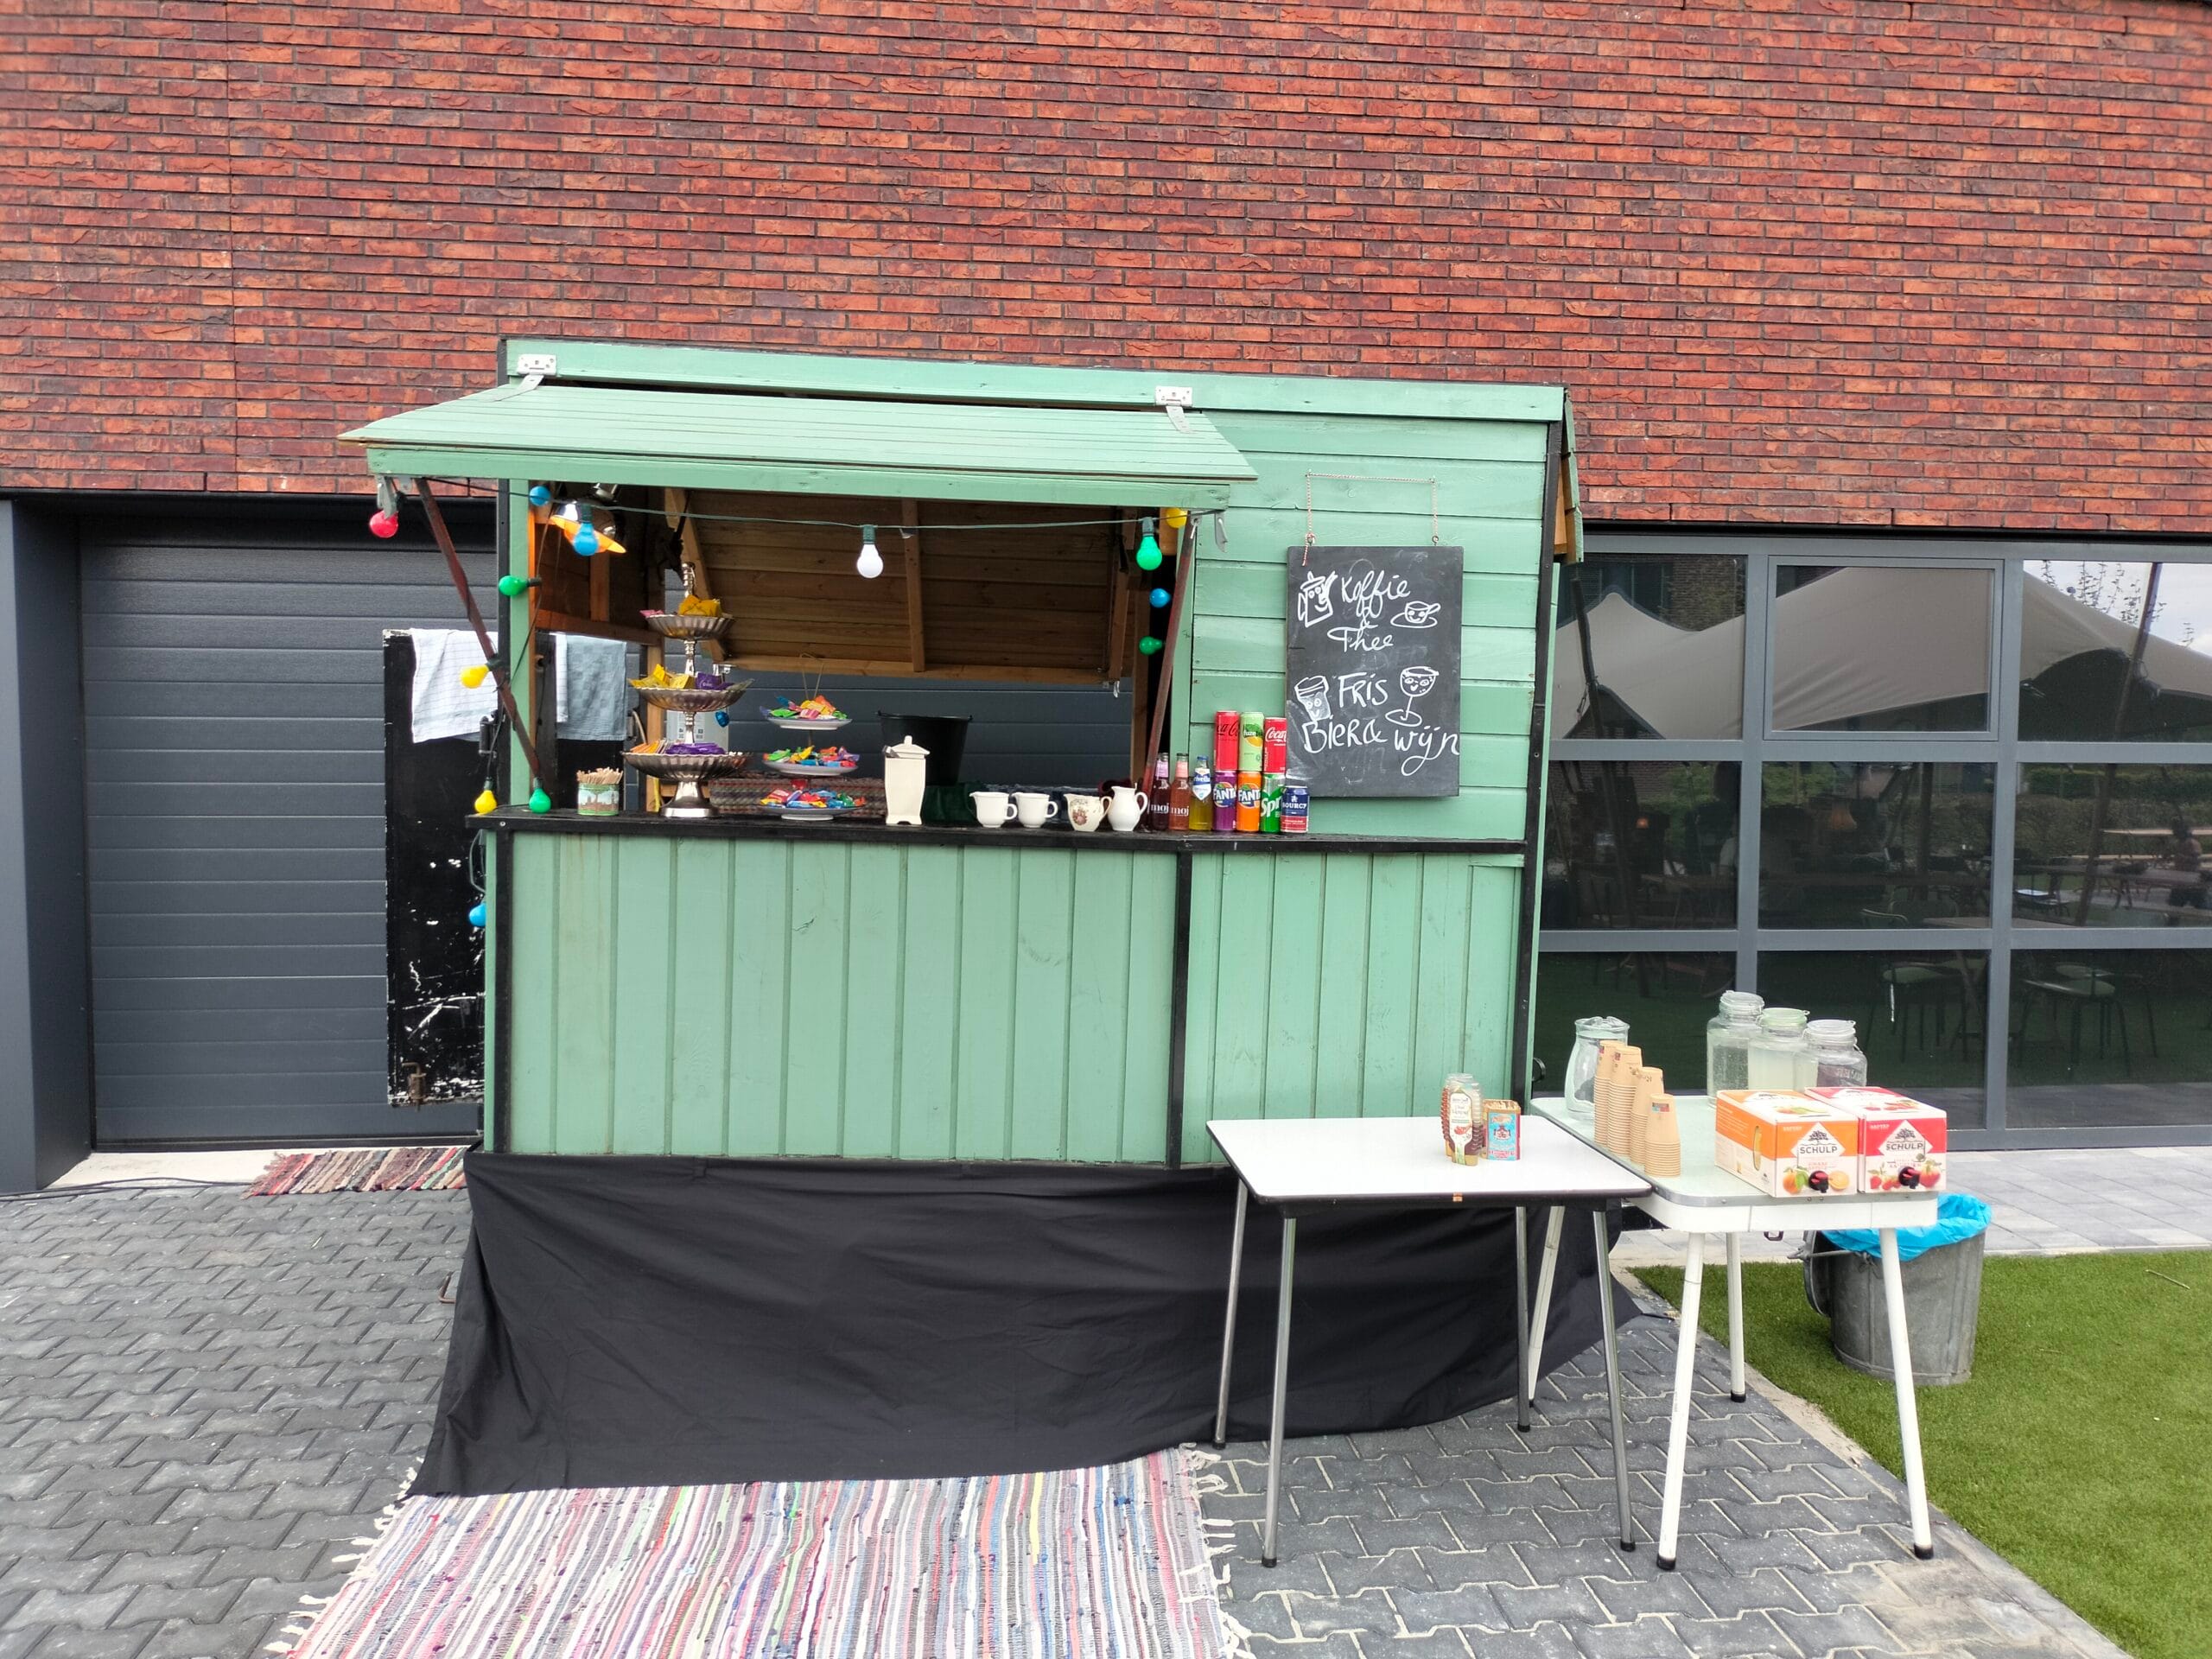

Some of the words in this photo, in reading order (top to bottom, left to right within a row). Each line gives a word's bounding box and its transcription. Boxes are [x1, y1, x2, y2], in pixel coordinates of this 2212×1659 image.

[1341, 569, 1411, 618] Koffie
[1326, 626, 1394, 652] Thee
[1261, 796, 1282, 817] Spr
[1800, 1146, 1839, 1154] SCHULP
[1885, 1141, 1924, 1150] SCHULP
